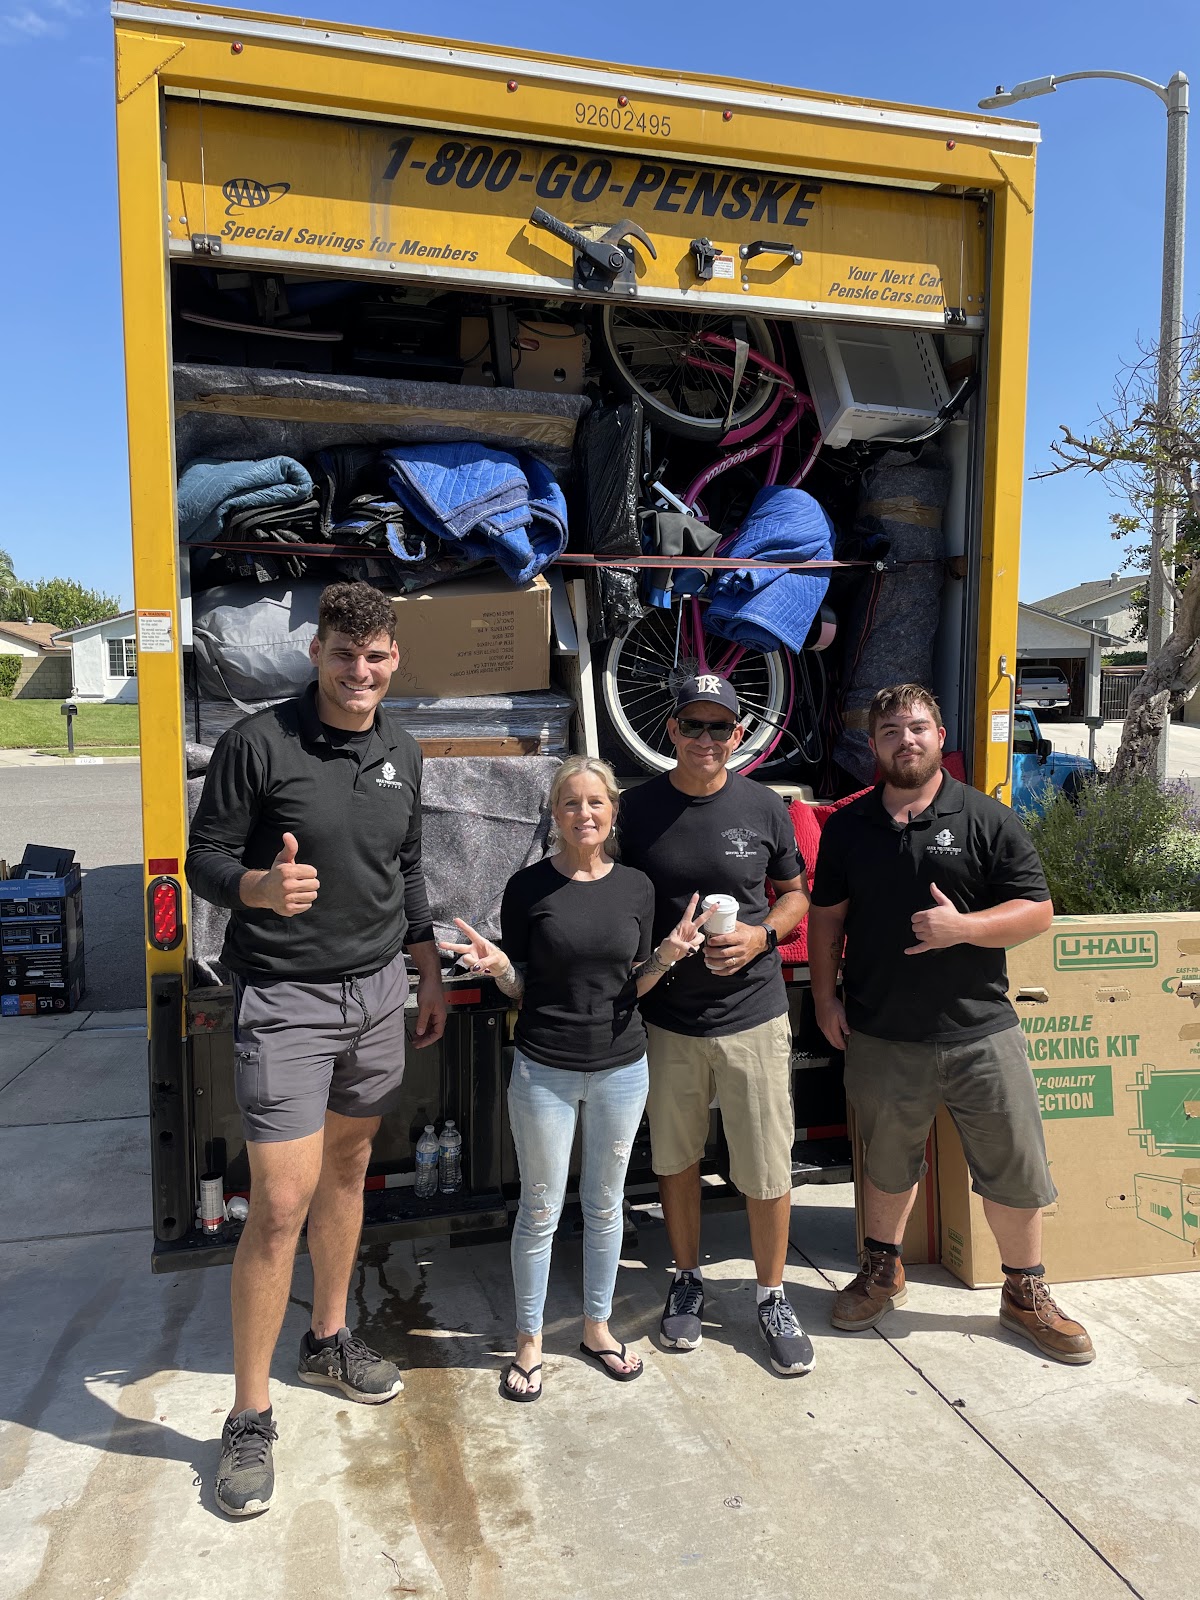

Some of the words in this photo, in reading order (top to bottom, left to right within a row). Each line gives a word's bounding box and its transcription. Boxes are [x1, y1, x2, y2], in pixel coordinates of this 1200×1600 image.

[575, 101, 672, 138] 92602495
[227, 180, 266, 206] AAA
[382, 135, 823, 228] 1-800-GO-PENSKE
[220, 220, 294, 243] Special
[293, 228, 365, 253] Savings
[369, 236, 397, 256] for
[399, 239, 478, 263] Members
[847, 265, 878, 284] Your
[880, 269, 916, 286] Next
[918, 273, 943, 288] Car
[1060, 937, 1152, 956] U-HAUL
[40, 1000, 53, 1008] LG
[1021, 1014, 1093, 1033] NDABLE
[1026, 1036, 1099, 1061] ACKING
[1106, 1034, 1140, 1057] KIT
[1036, 1074, 1095, 1089] Y-QUALITY
[1038, 1092, 1094, 1112] ECTION
